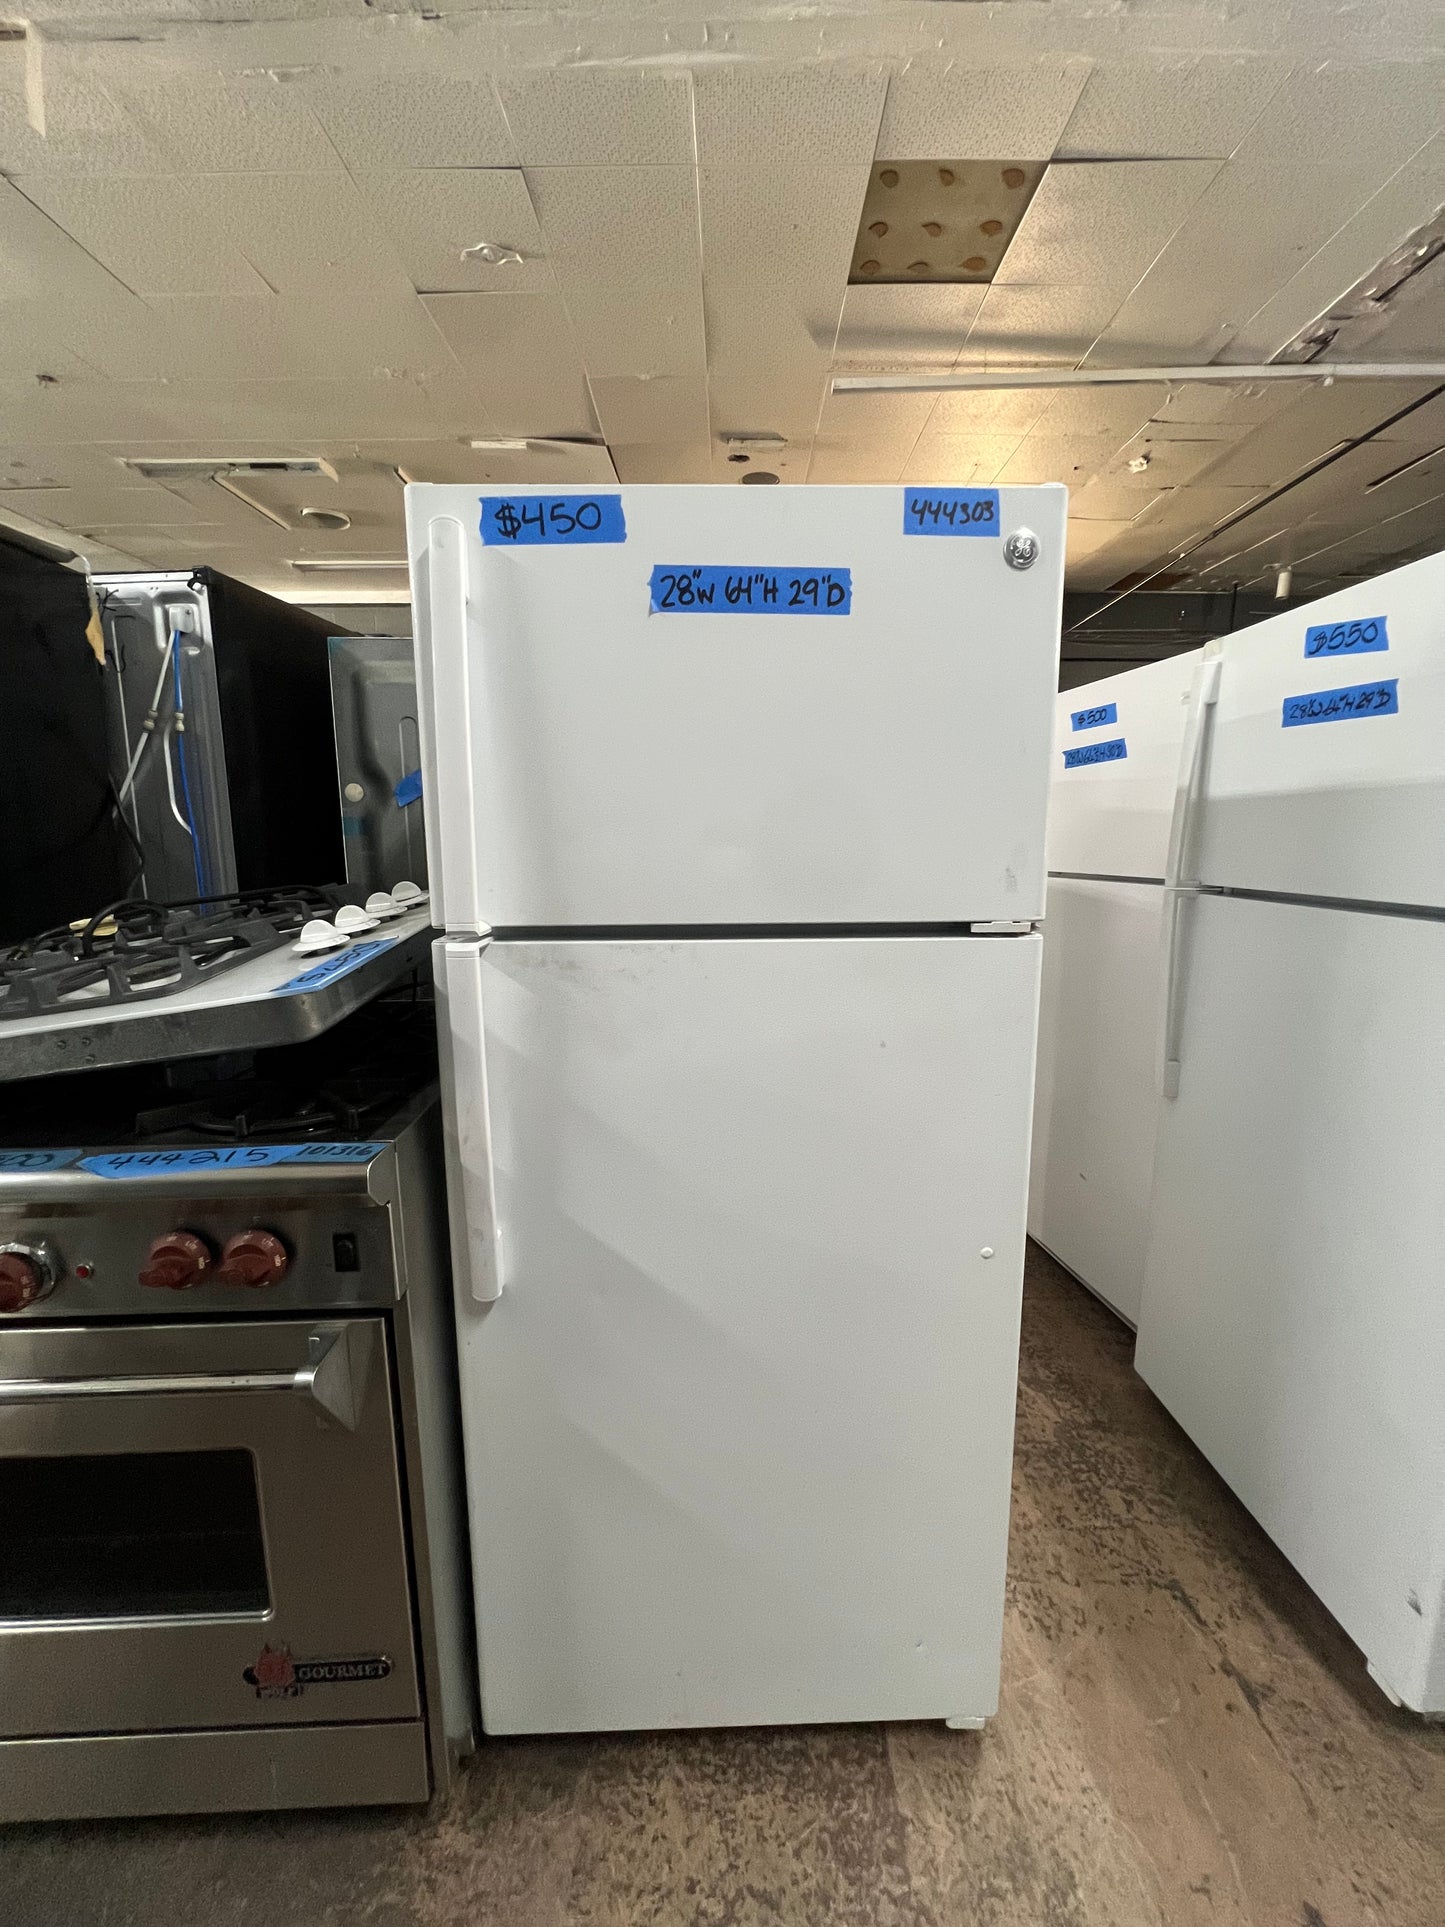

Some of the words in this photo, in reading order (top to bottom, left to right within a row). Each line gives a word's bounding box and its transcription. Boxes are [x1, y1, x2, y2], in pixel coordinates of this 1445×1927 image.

[495, 502, 602, 540] $450
[911, 499, 994, 526] 444303
[1308, 620, 1379, 655] $550
[1077, 708, 1107, 726] $500
[108, 1148, 270, 1169] 444215
[299, 1664, 387, 1680] GOURMET
